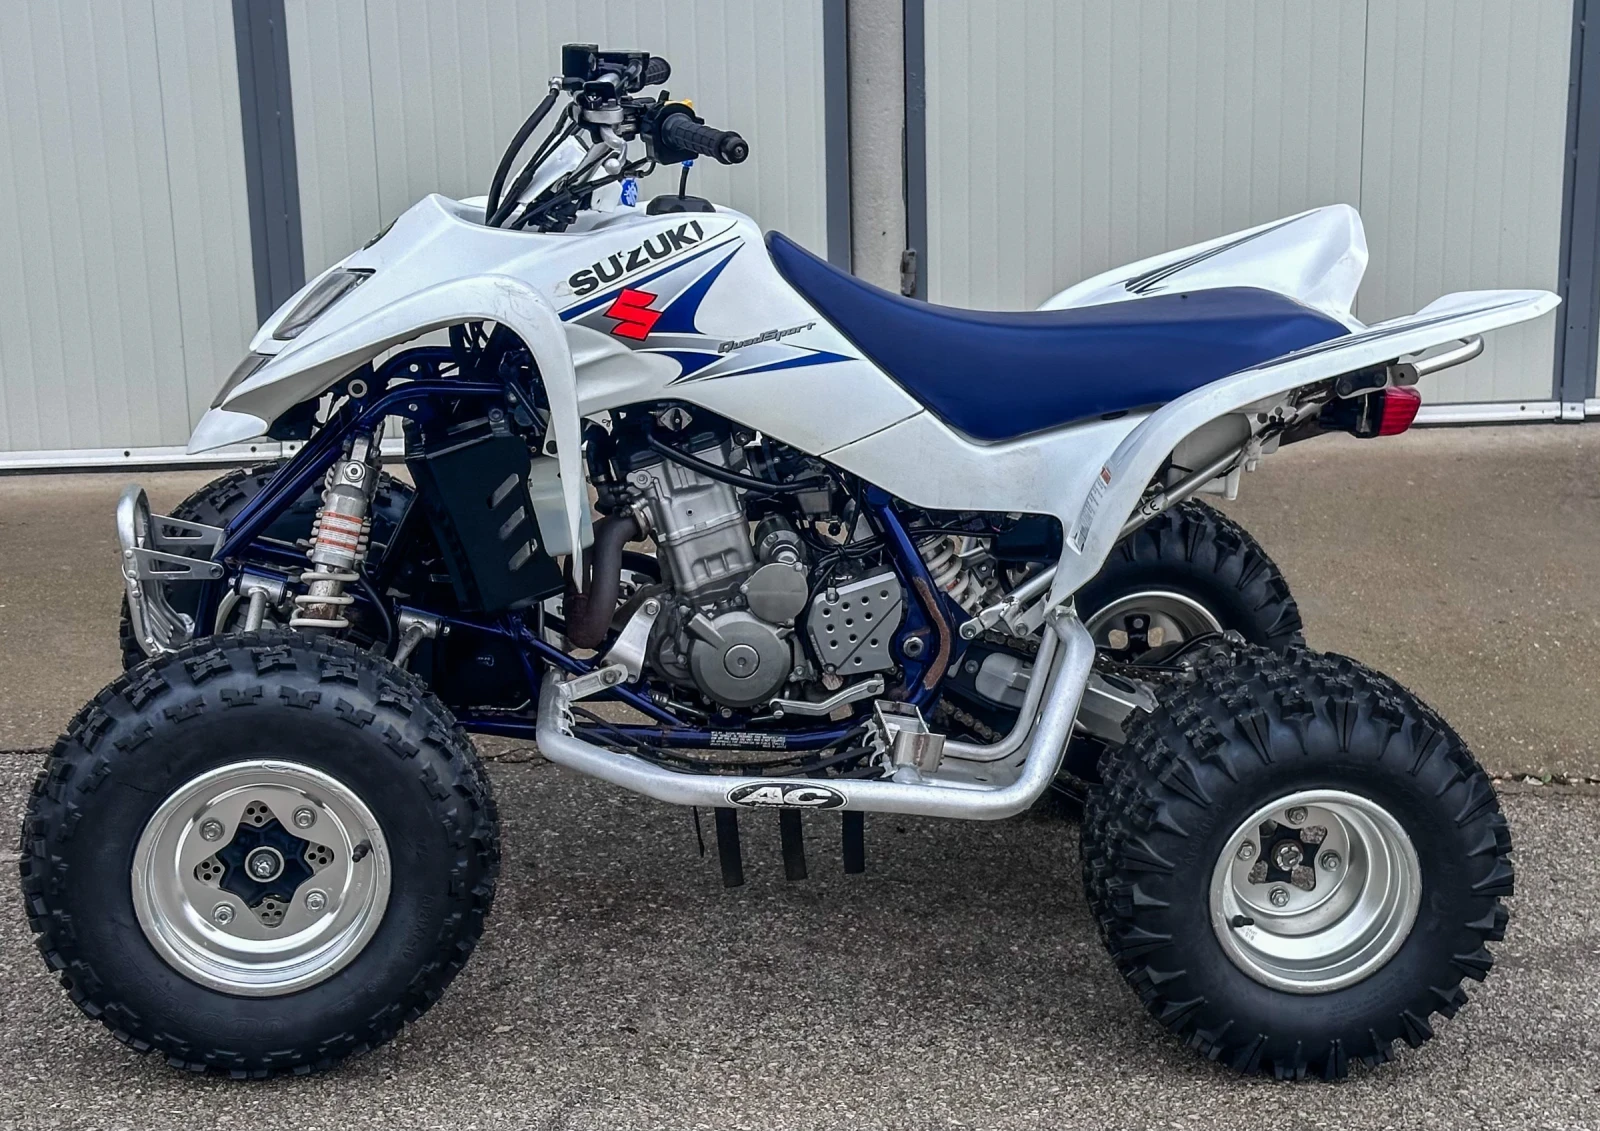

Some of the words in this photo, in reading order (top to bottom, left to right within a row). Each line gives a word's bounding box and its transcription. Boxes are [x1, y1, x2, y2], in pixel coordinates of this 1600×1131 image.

[567, 220, 704, 296] SUZUKI
[718, 322, 817, 353] QuadSport
[1141, 500, 1160, 516] CE
